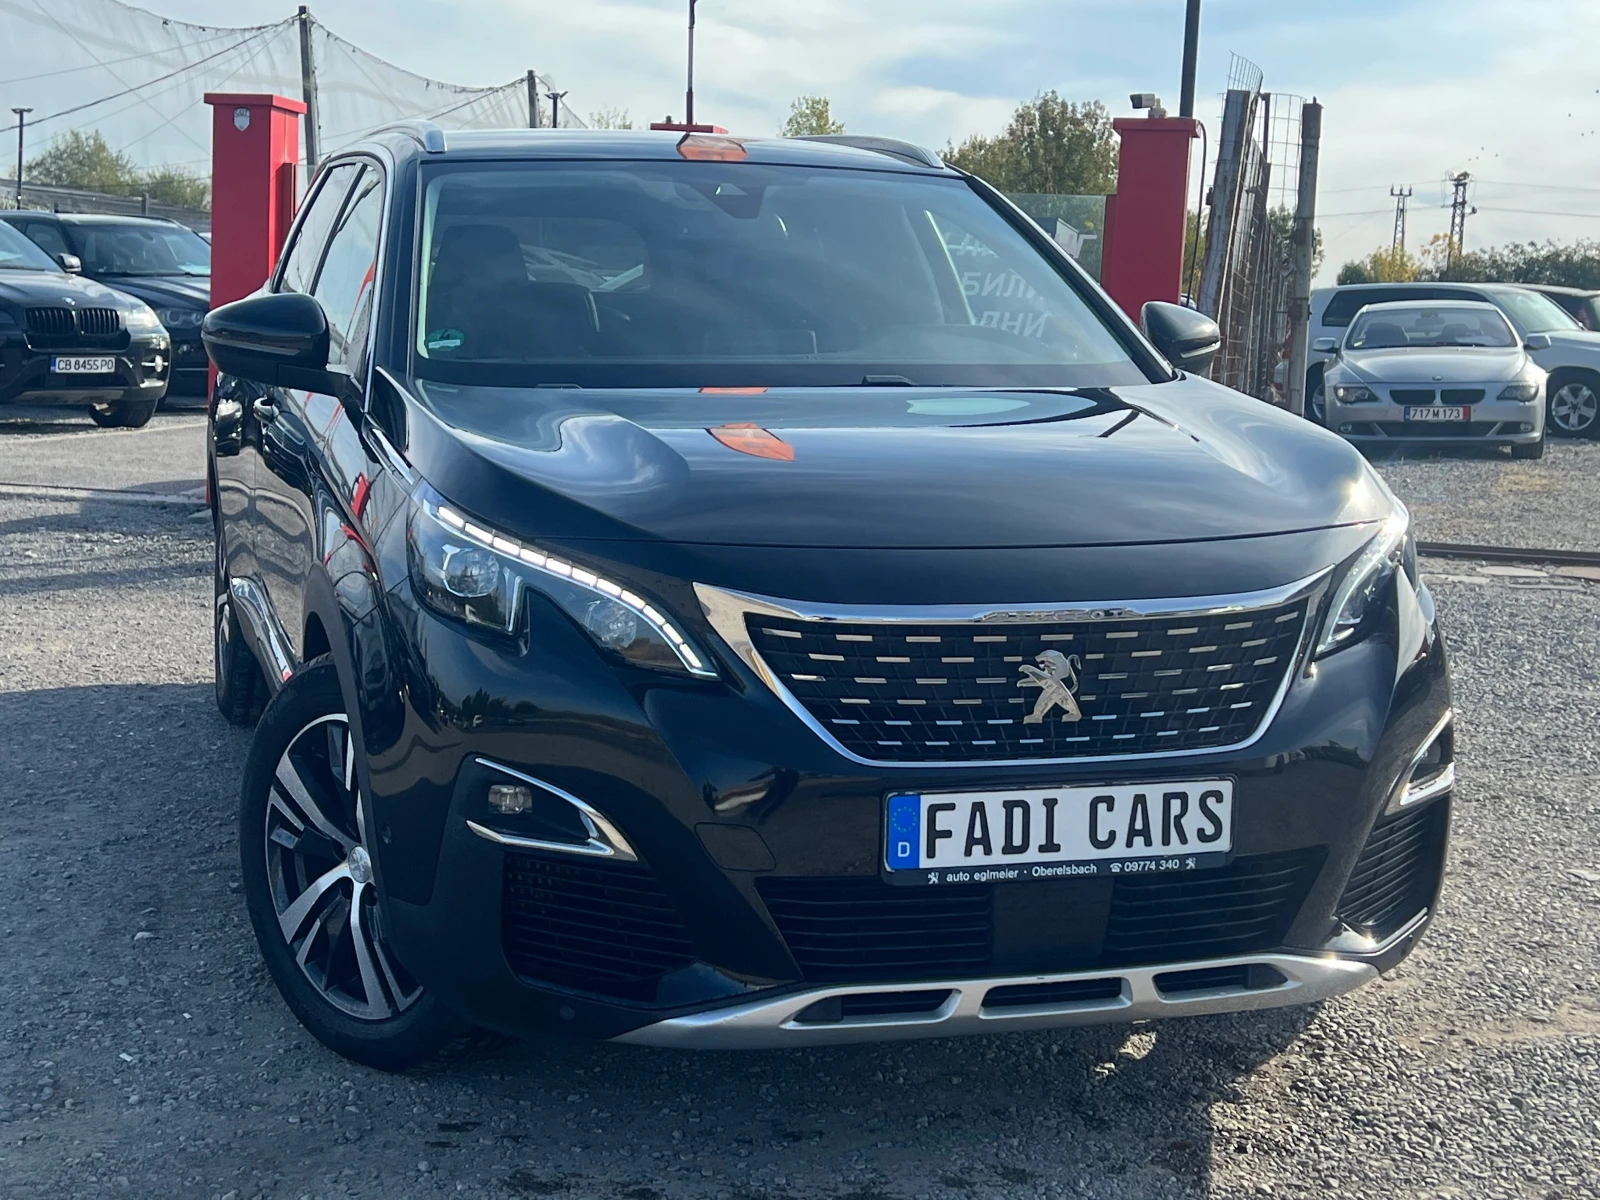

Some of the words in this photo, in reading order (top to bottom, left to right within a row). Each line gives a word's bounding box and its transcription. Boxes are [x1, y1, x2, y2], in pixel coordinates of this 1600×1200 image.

[73, 359, 99, 371] 8455
[1411, 408, 1431, 419] 717
[1442, 408, 1460, 419] 173
[926, 797, 1062, 859] FADI
[1088, 790, 1224, 850] CARS
[897, 842, 910, 857] D
[946, 870, 970, 882] auto
[973, 867, 1020, 882] eglmeier
[1031, 863, 1097, 877] Oberelsbach
[1123, 860, 1156, 873] 09774
[1158, 859, 1180, 871] 340
